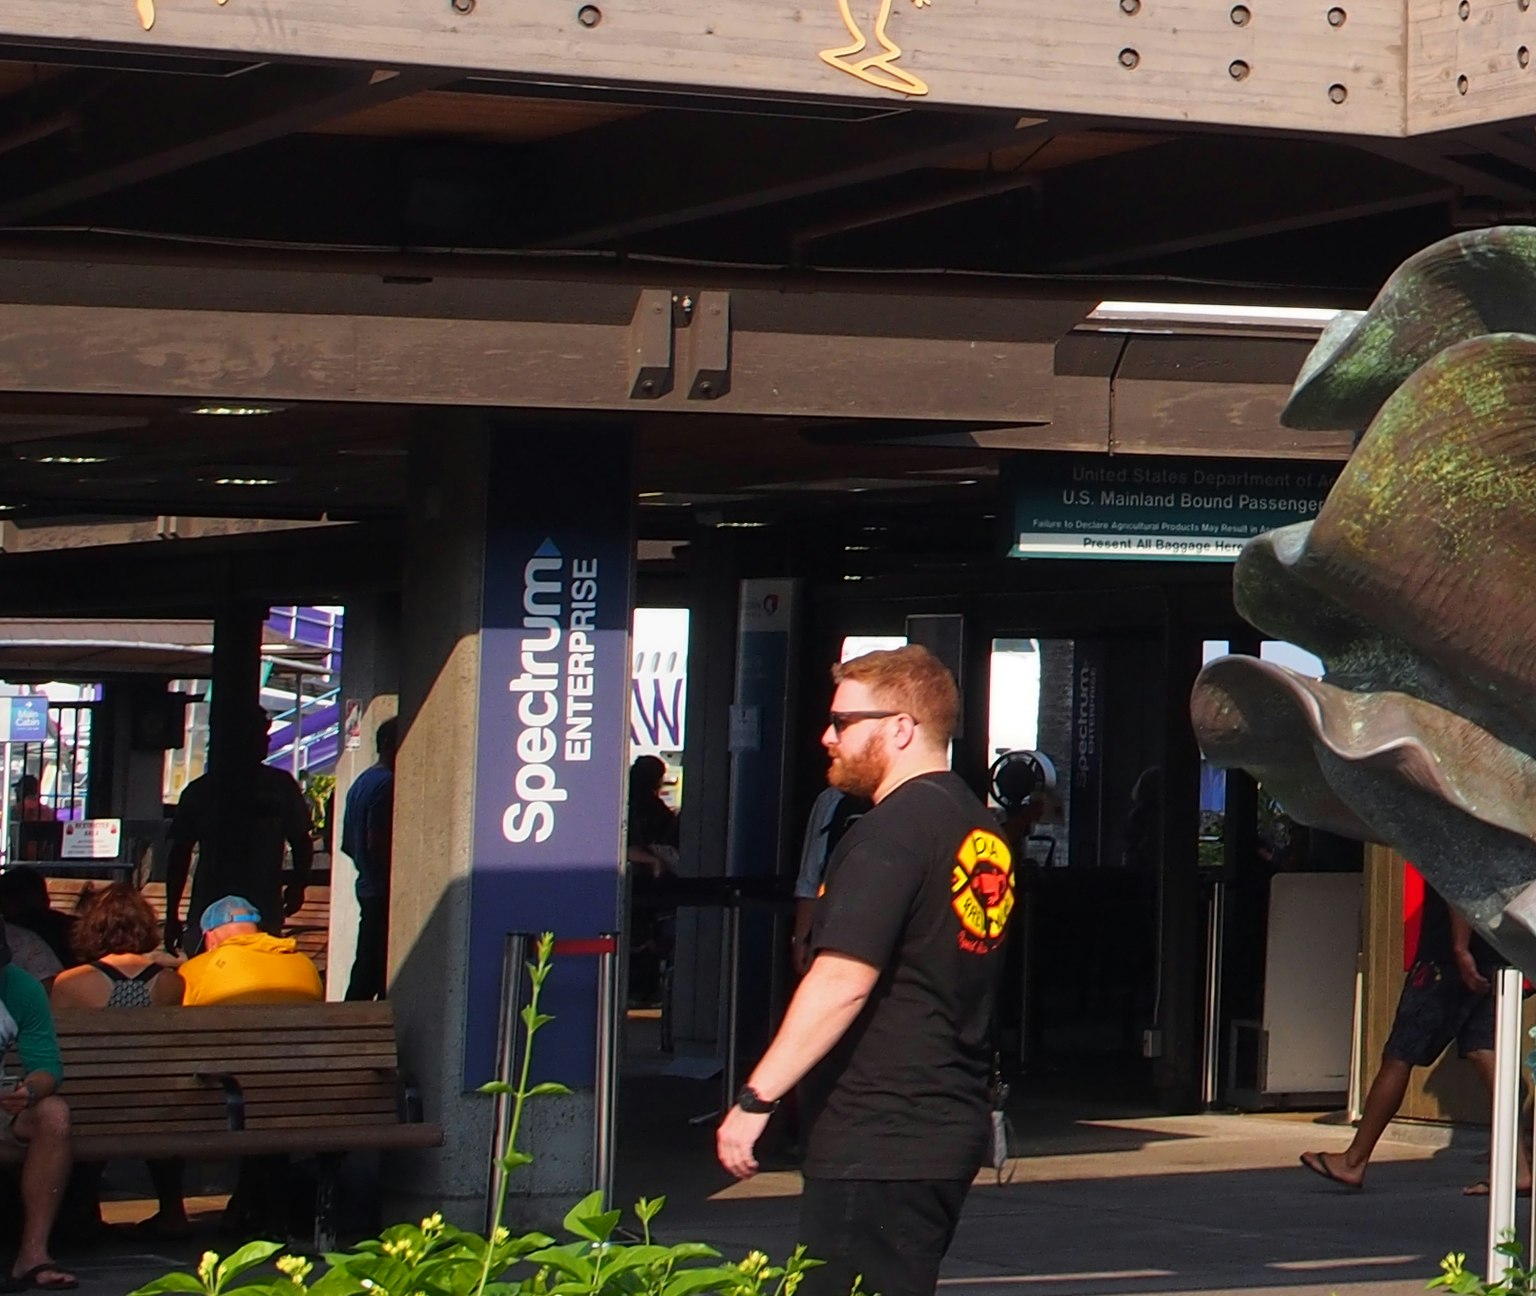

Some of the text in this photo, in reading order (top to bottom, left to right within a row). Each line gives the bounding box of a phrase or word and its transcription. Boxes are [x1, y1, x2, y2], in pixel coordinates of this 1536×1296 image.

[1072, 466, 1127, 482] United
[1133, 467, 1187, 484] States
[1193, 469, 1290, 488] Department
[1295, 472, 1313, 488] of
[1062, 489, 1095, 505] U.S.
[1100, 490, 1175, 507] Mainland
[1180, 492, 1233, 508] Bound
[1032, 518, 1062, 528] Failure
[1064, 519, 1074, 529] to
[1075, 520, 1108, 529] Declare
[1111, 521, 1160, 532] Agricultural
[1161, 522, 1199, 532] Products
[1201, 523, 1219, 534] May
[1221, 524, 1248, 534] Result
[1249, 525, 1258, 534] in
[1083, 537, 1243, 553] Present All Baggage Here
[564, 558, 598, 761] ENTERPRISE
[502, 558, 568, 843] Spectrum
[1076, 667, 1090, 788] Spectrum
